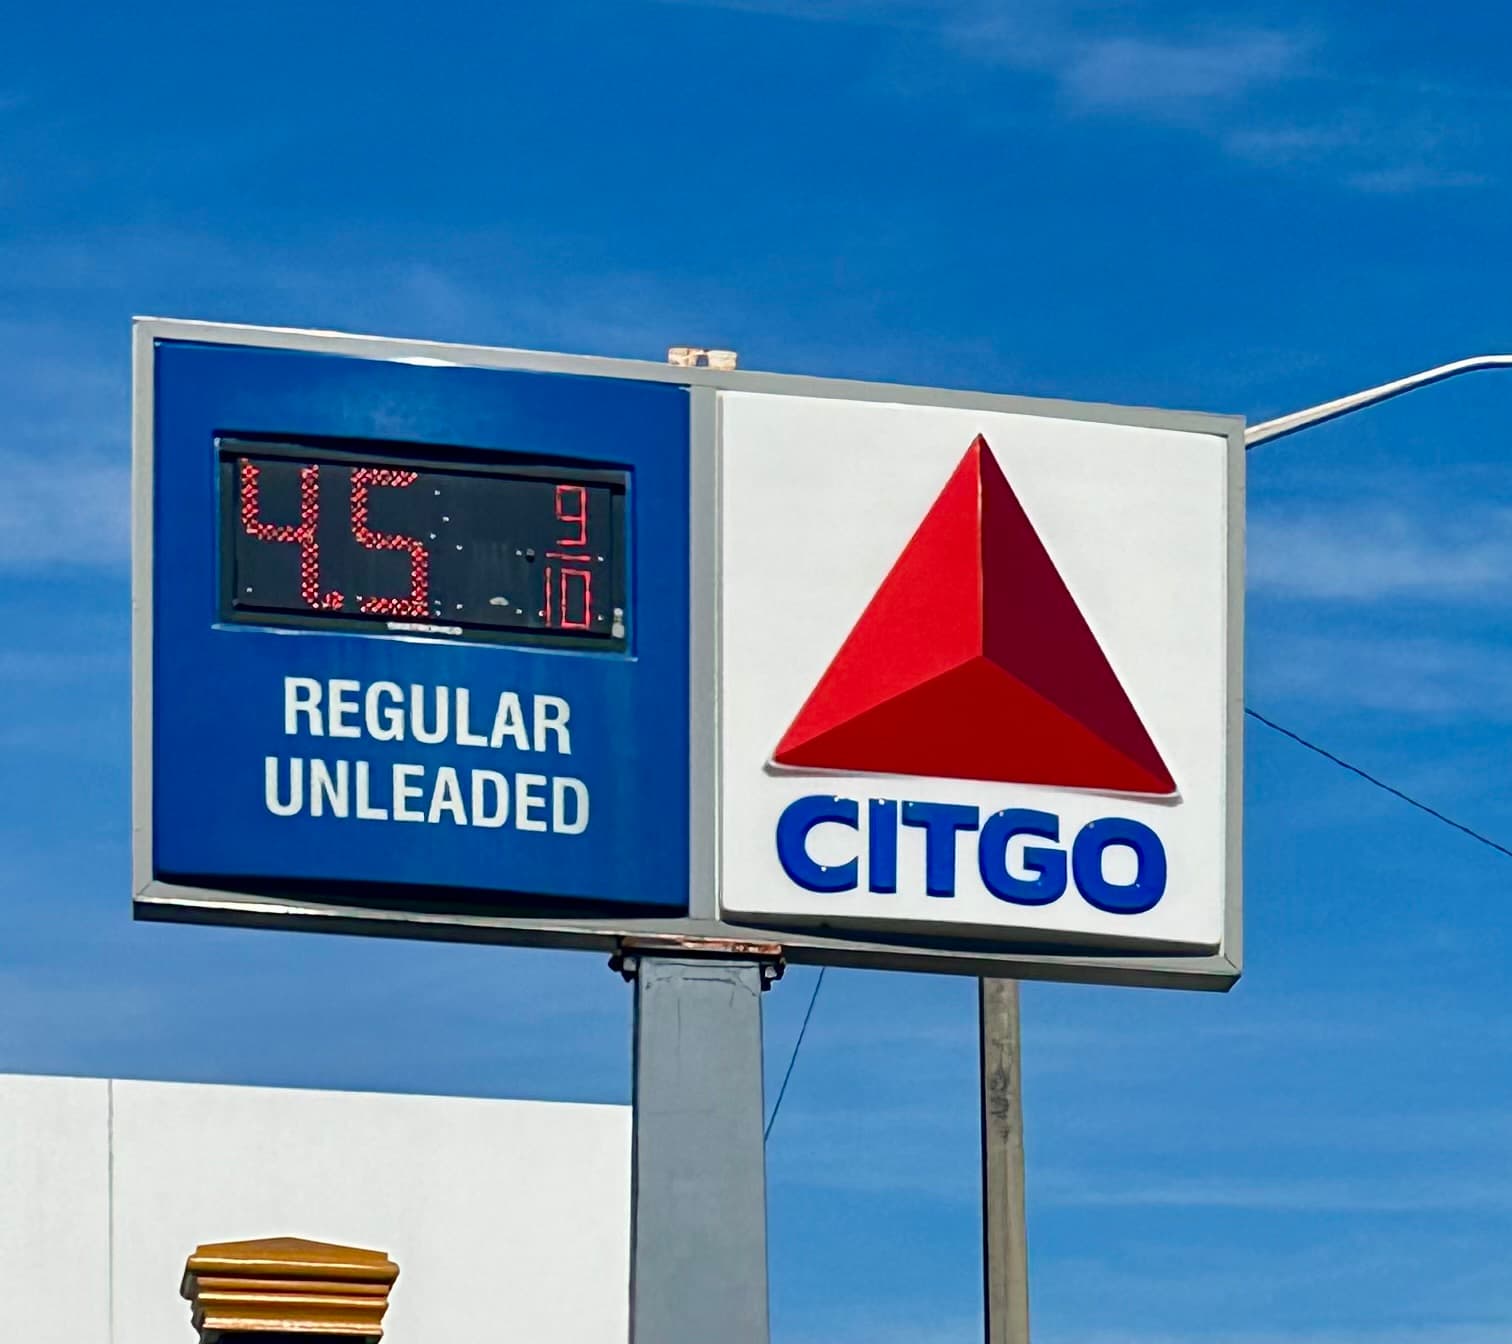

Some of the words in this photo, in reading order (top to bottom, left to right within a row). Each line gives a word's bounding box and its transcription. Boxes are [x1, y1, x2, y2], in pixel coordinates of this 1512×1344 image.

[284, 676, 571, 755] REGULAR
[265, 755, 589, 835] UNLEADED
[774, 793, 1169, 917] CITGO
